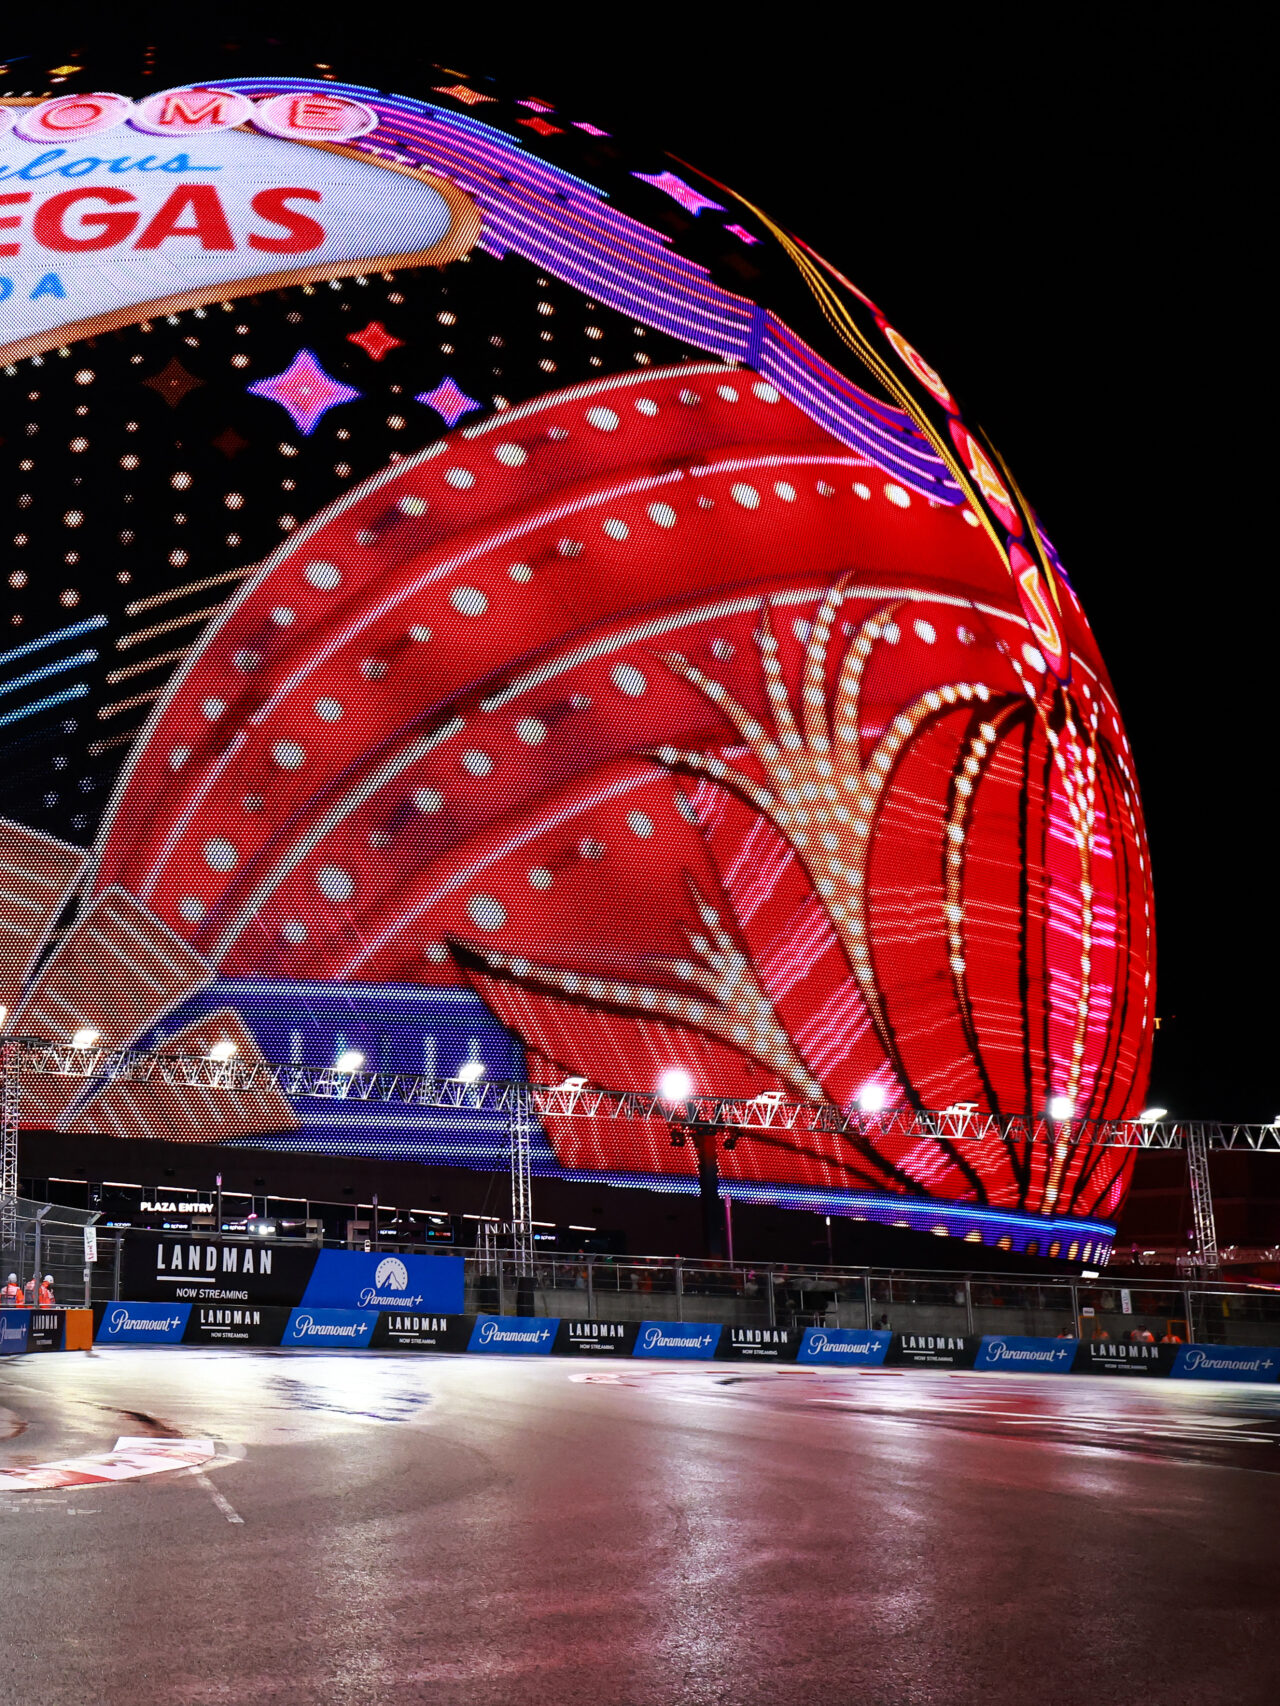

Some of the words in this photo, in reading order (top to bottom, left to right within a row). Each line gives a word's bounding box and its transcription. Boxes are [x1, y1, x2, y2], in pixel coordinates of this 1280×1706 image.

[140, 1202, 177, 1212] PLAZA
[178, 1203, 214, 1213] ENTRY
[157, 1244, 272, 1274] LANDMAN
[176, 1288, 197, 1298] NOW
[199, 1289, 248, 1300] STREAMING
[357, 1288, 423, 1307] Paramount+
[109, 1309, 181, 1333] Paramount+
[200, 1310, 260, 1325] LANDMAN
[293, 1314, 368, 1338] Paramount+
[388, 1316, 447, 1331] LANDMAN
[479, 1322, 550, 1344] Paramount+
[569, 1323, 624, 1337] LANDMAN
[643, 1328, 712, 1349] Paramount+
[731, 1329, 788, 1343] LANDMAN
[808, 1334, 881, 1354] Paramount+
[902, 1335, 964, 1350] LANDMAN
[986, 1341, 1067, 1362] Paramount+
[1090, 1344, 1159, 1359] LANDMAN
[1184, 1350, 1273, 1371] Paramount+
